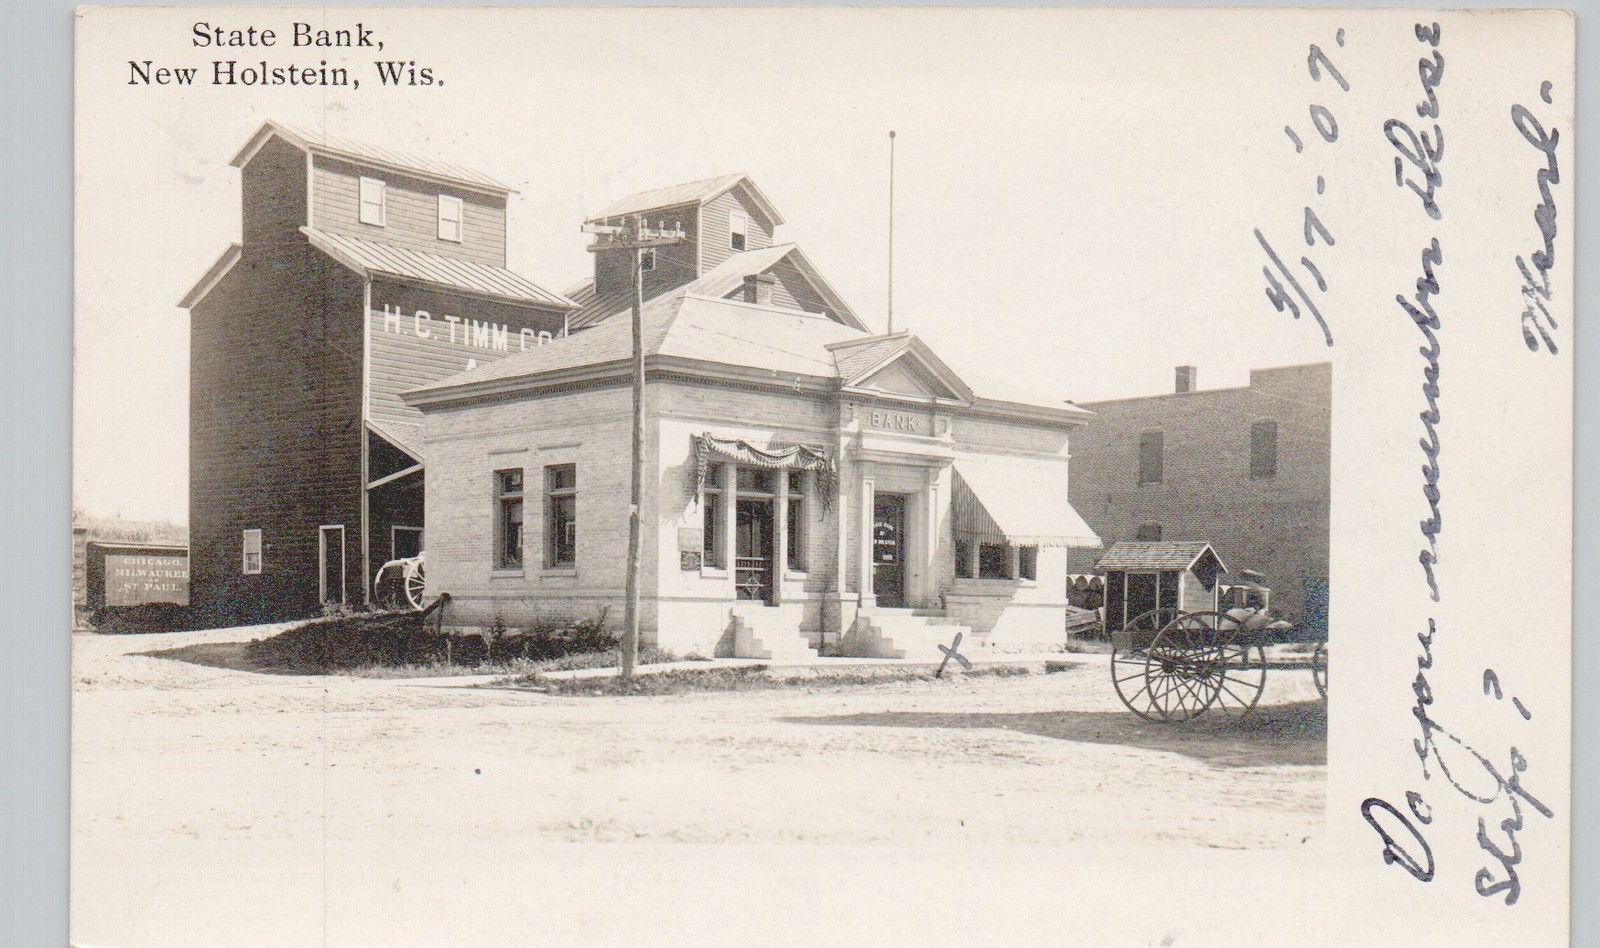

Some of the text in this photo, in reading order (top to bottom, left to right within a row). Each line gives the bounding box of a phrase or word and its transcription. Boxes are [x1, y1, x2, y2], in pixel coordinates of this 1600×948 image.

[1383, 22, 1444, 219] these
[444, 315, 508, 351] TIMM
[870, 411, 916, 431] BANK
[115, 568, 189, 578] MILWAUKEE
[1412, 617, 1501, 803] you
[1361, 791, 1434, 882] Do
